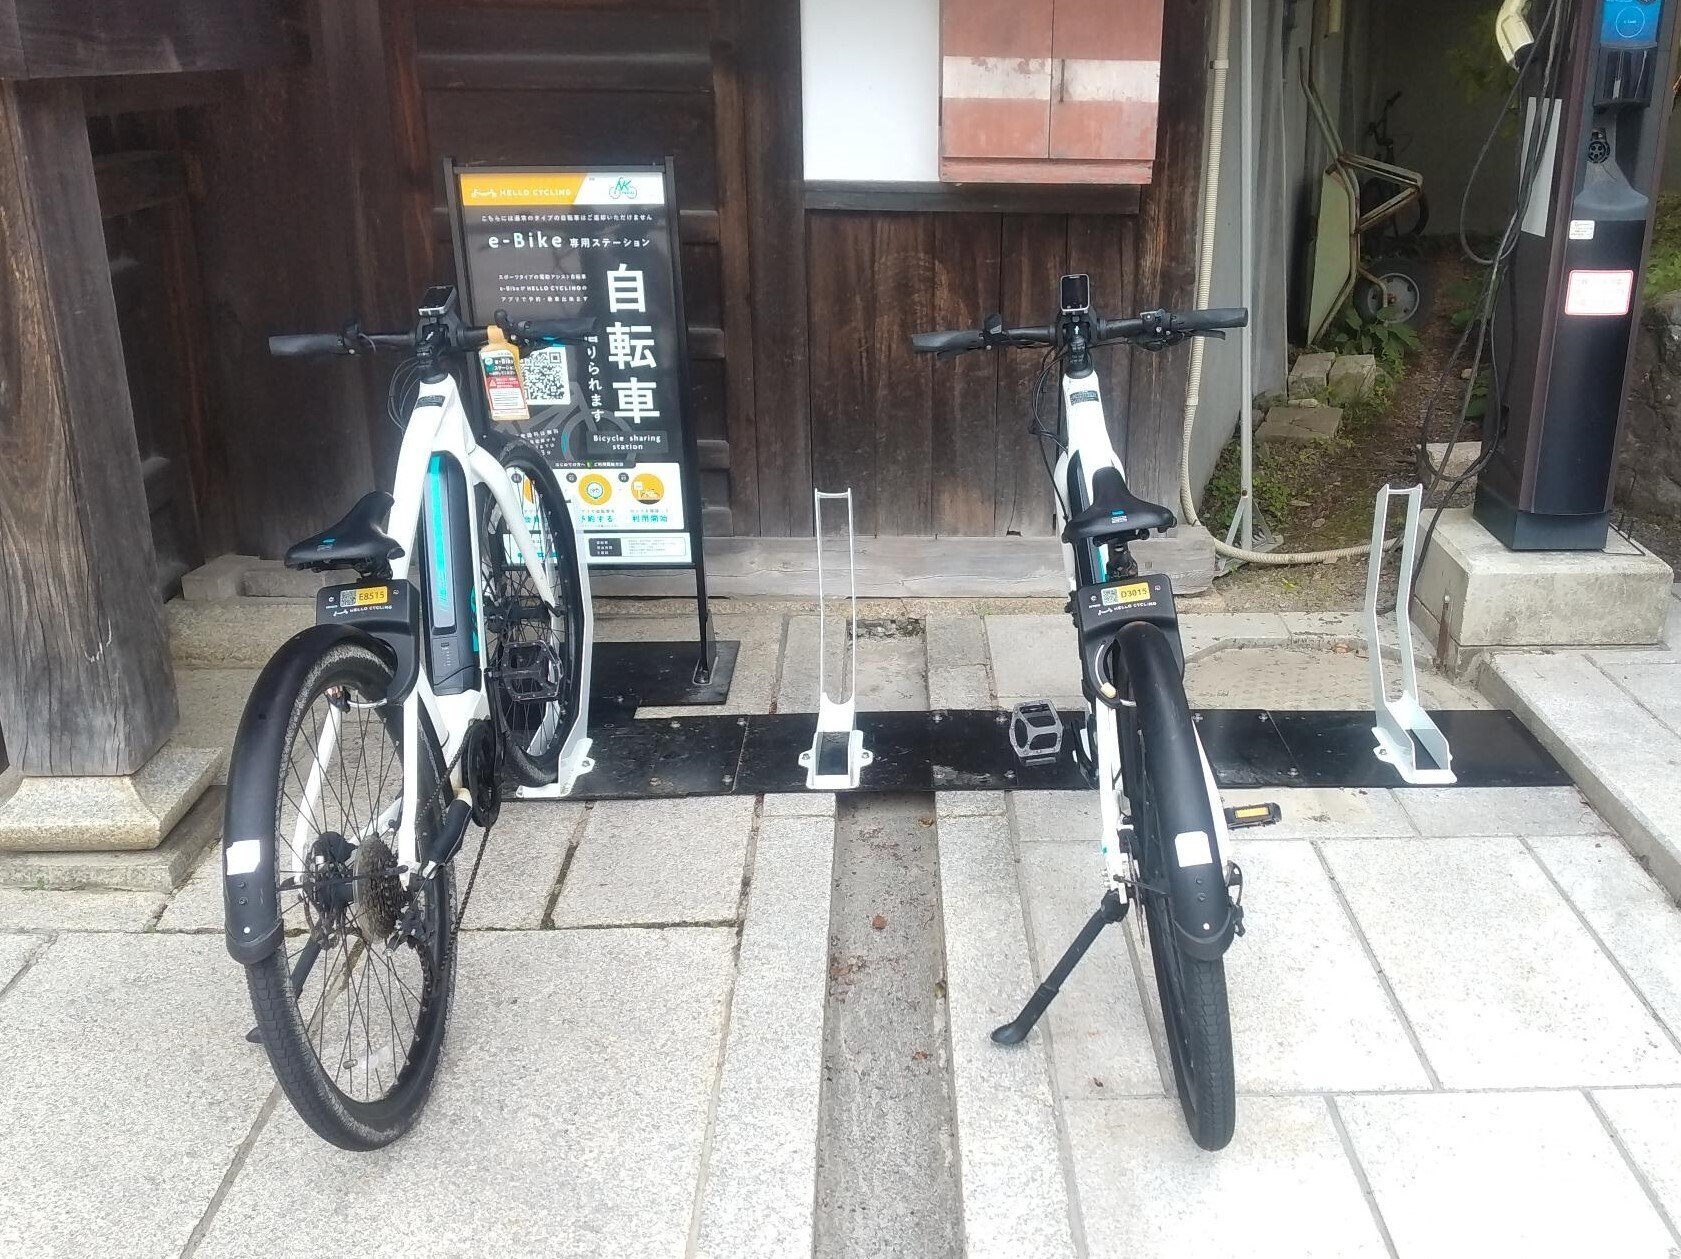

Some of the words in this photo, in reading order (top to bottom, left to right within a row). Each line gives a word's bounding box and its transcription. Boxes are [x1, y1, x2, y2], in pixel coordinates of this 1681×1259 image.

[499, 188, 530, 196] HELLO
[532, 188, 572, 196] CYCLING
[488, 231, 562, 248] e-Bike
[569, 237, 650, 249] 専用ステーション
[606, 263, 660, 424] 自転車
[593, 434, 624, 444] Bicycle
[629, 434, 661, 444] sharing
[1120, 587, 1148, 598] D3015
